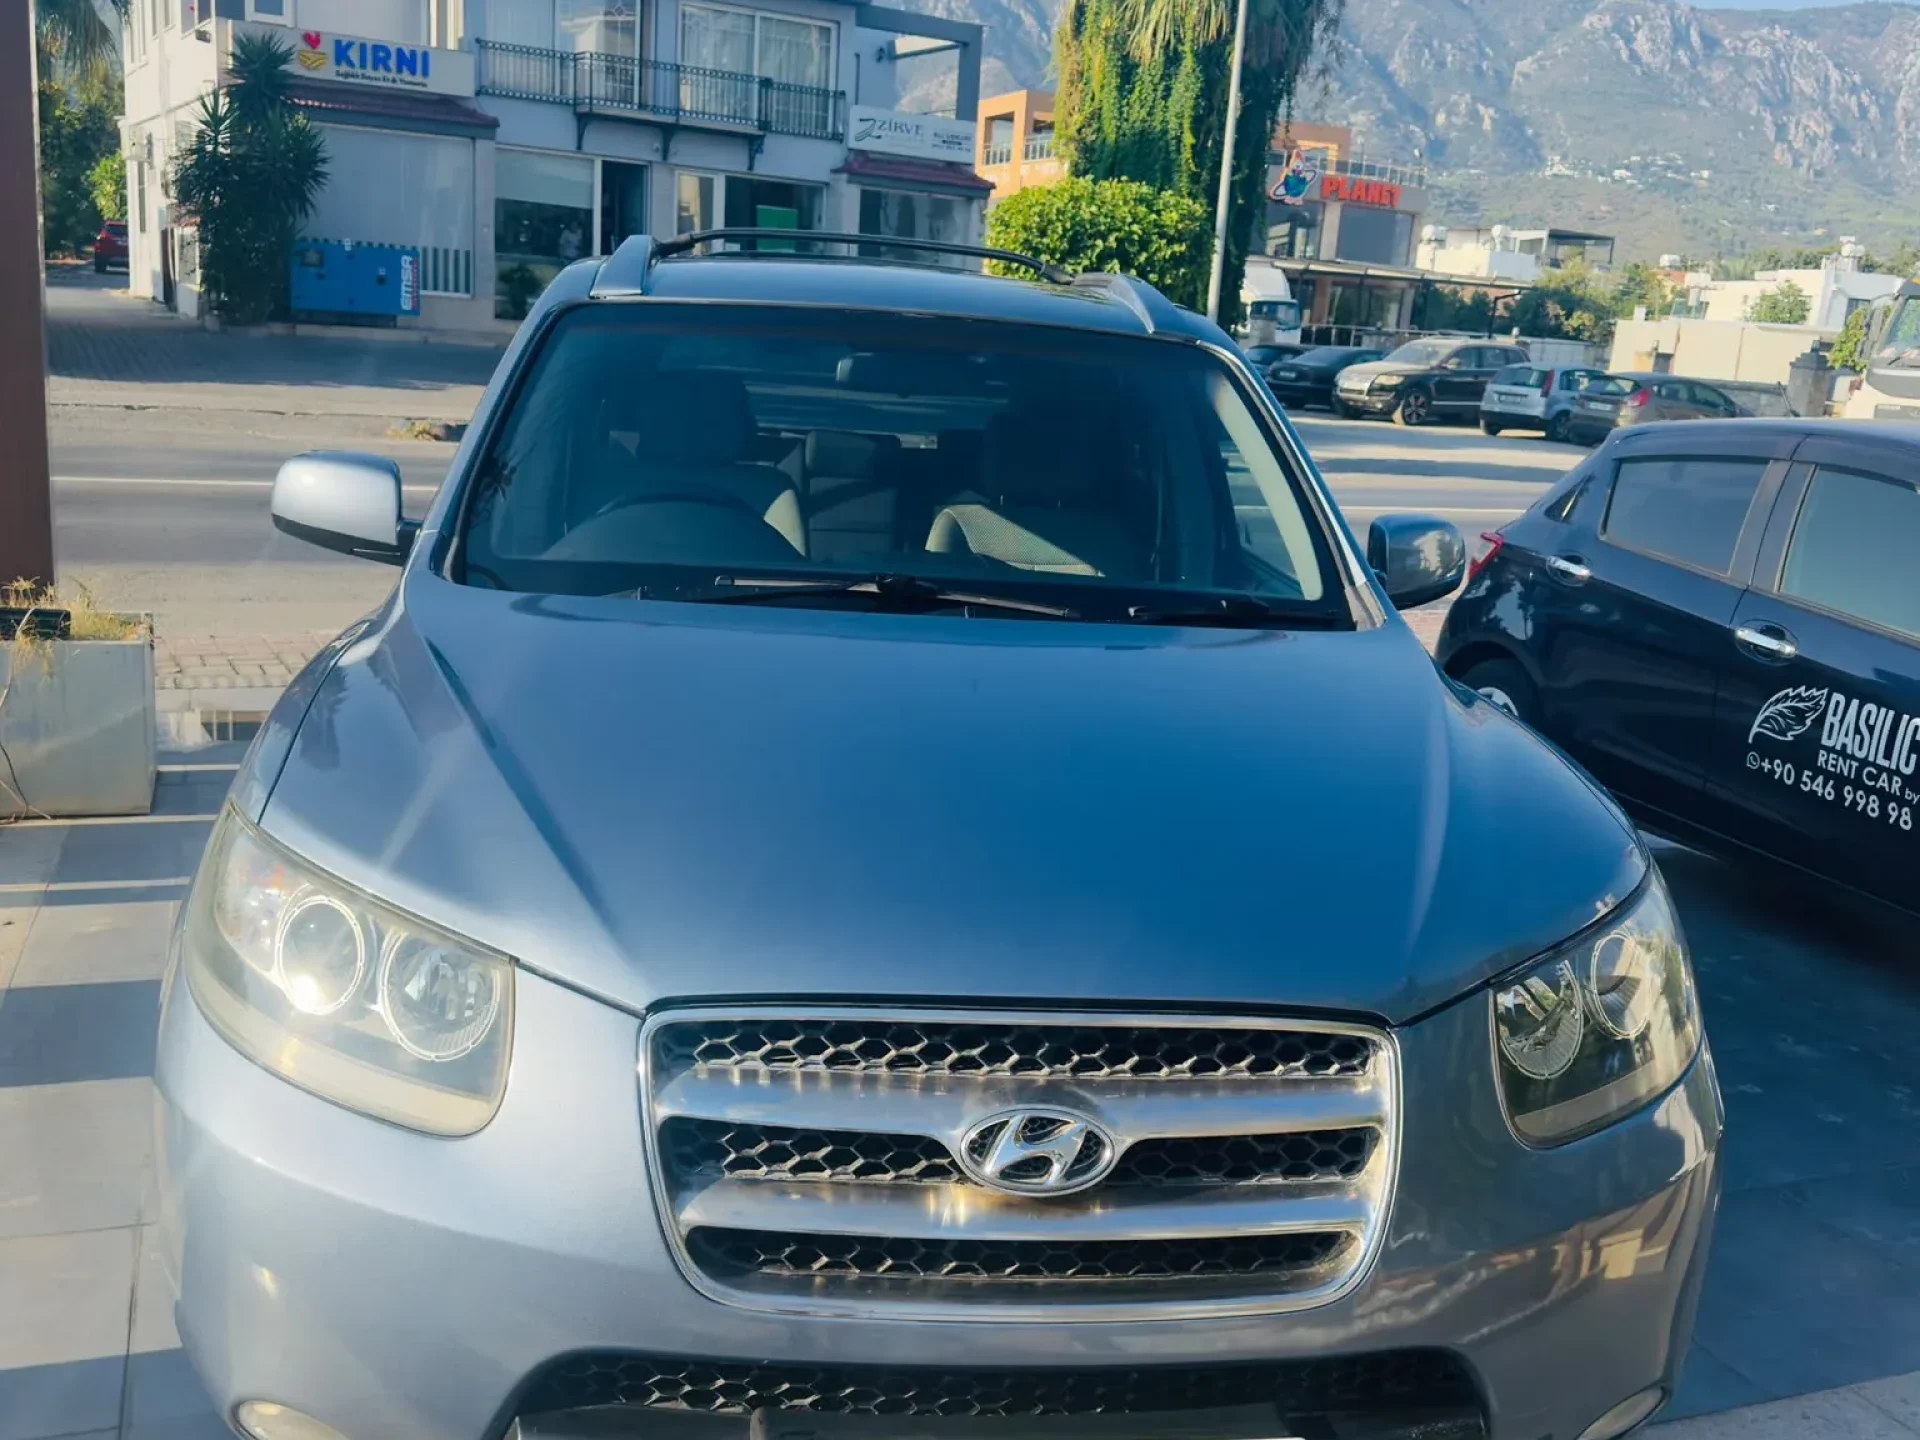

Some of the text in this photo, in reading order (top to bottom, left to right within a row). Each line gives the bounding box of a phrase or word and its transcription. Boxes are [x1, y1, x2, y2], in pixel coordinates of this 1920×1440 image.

[334, 39, 430, 78] KIRNI
[1321, 176, 1402, 207] PLANET
[1820, 692, 1920, 775] BASILIC
[1760, 757, 1912, 831] +90 546 998 98
[1817, 749, 1920, 804] RENT CAR by
